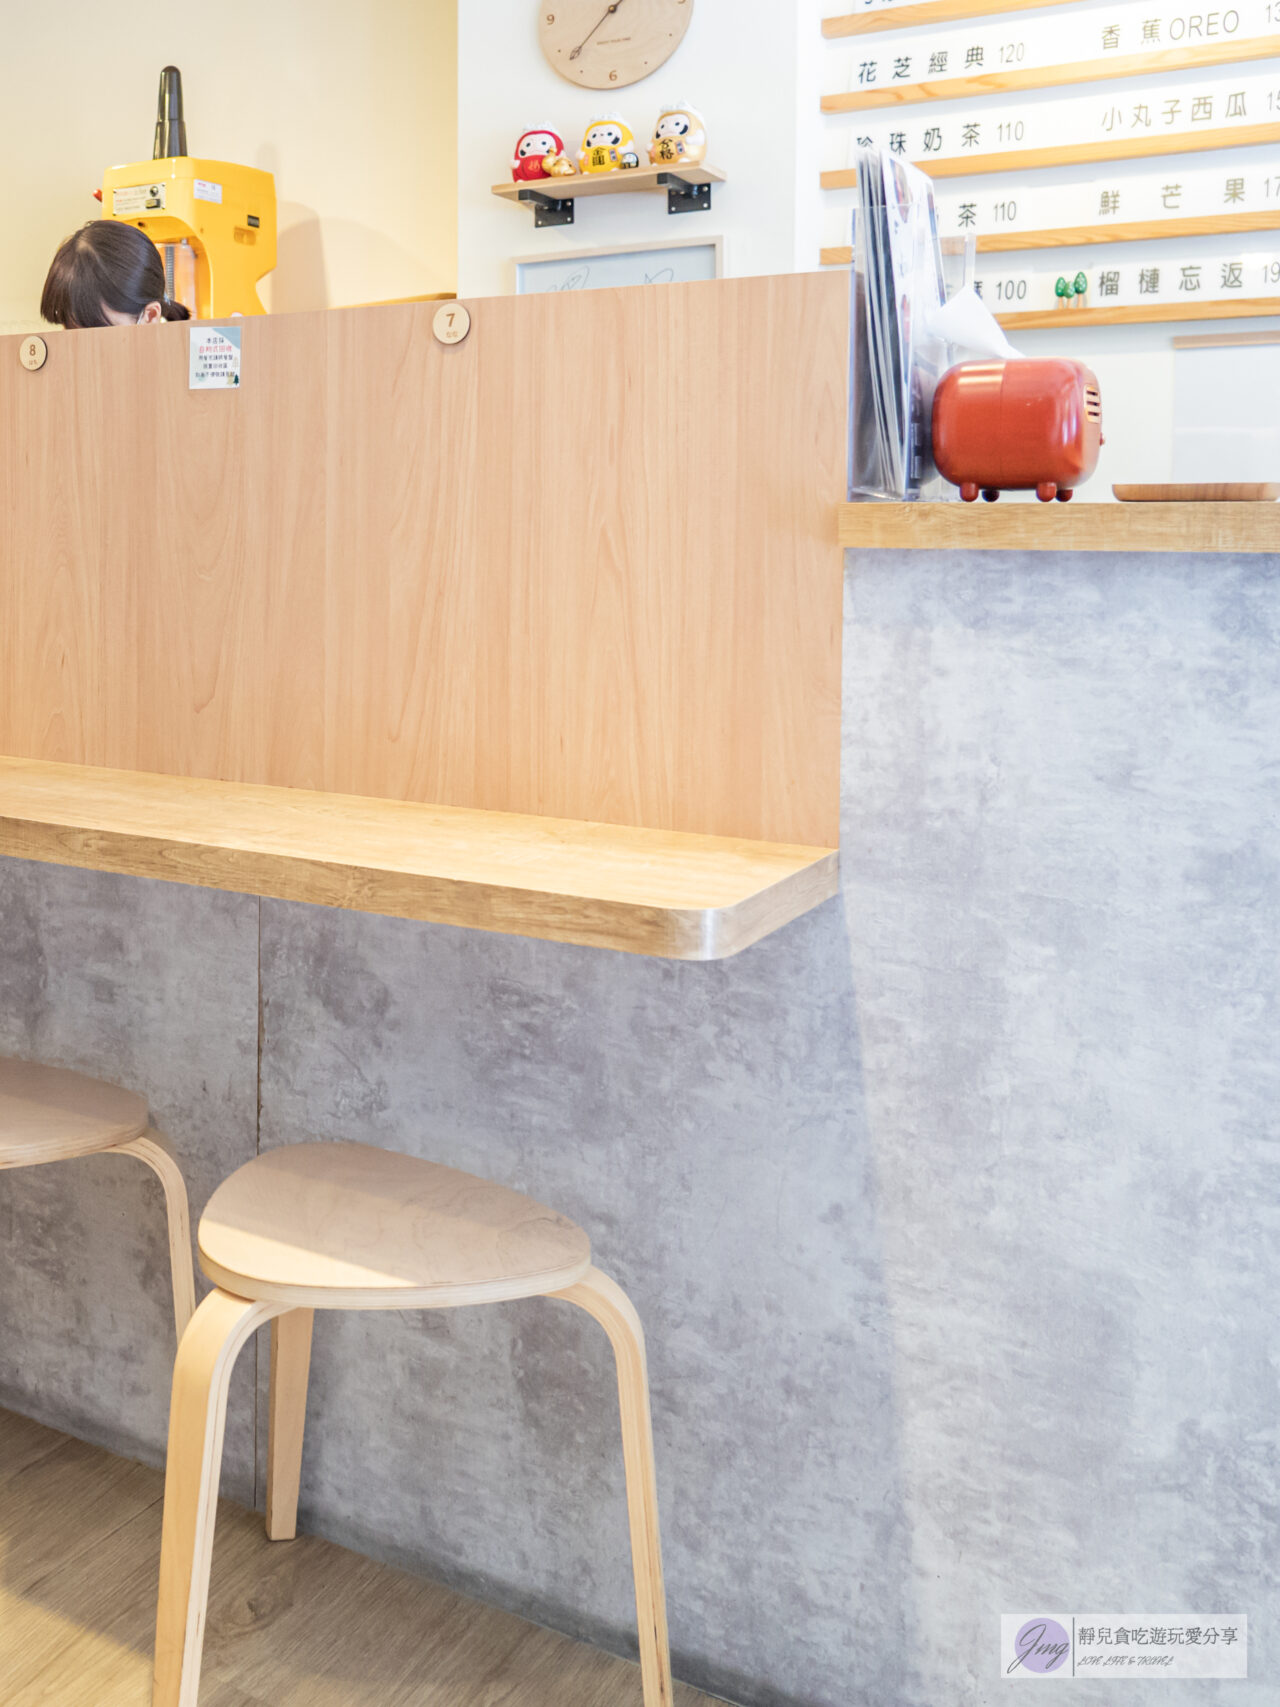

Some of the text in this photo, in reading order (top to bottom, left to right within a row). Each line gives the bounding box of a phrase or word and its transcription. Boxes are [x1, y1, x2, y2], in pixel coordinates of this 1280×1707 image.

[546, 14, 556, 26] 9
[998, 42, 1025, 64] 120
[609, 69, 618, 82] 6
[858, 45, 985, 84] 花芝經典
[1101, 91, 1248, 132] 小丸子西瓜
[997, 120, 1025, 143] 110
[1099, 177, 1246, 216] 鮮芒果
[993, 200, 1018, 223] 110
[996, 279, 1028, 301] 100
[1098, 262, 1244, 297] 榴槤忘返
[445, 312, 456, 328] 7
[29, 344, 37, 356] 8
